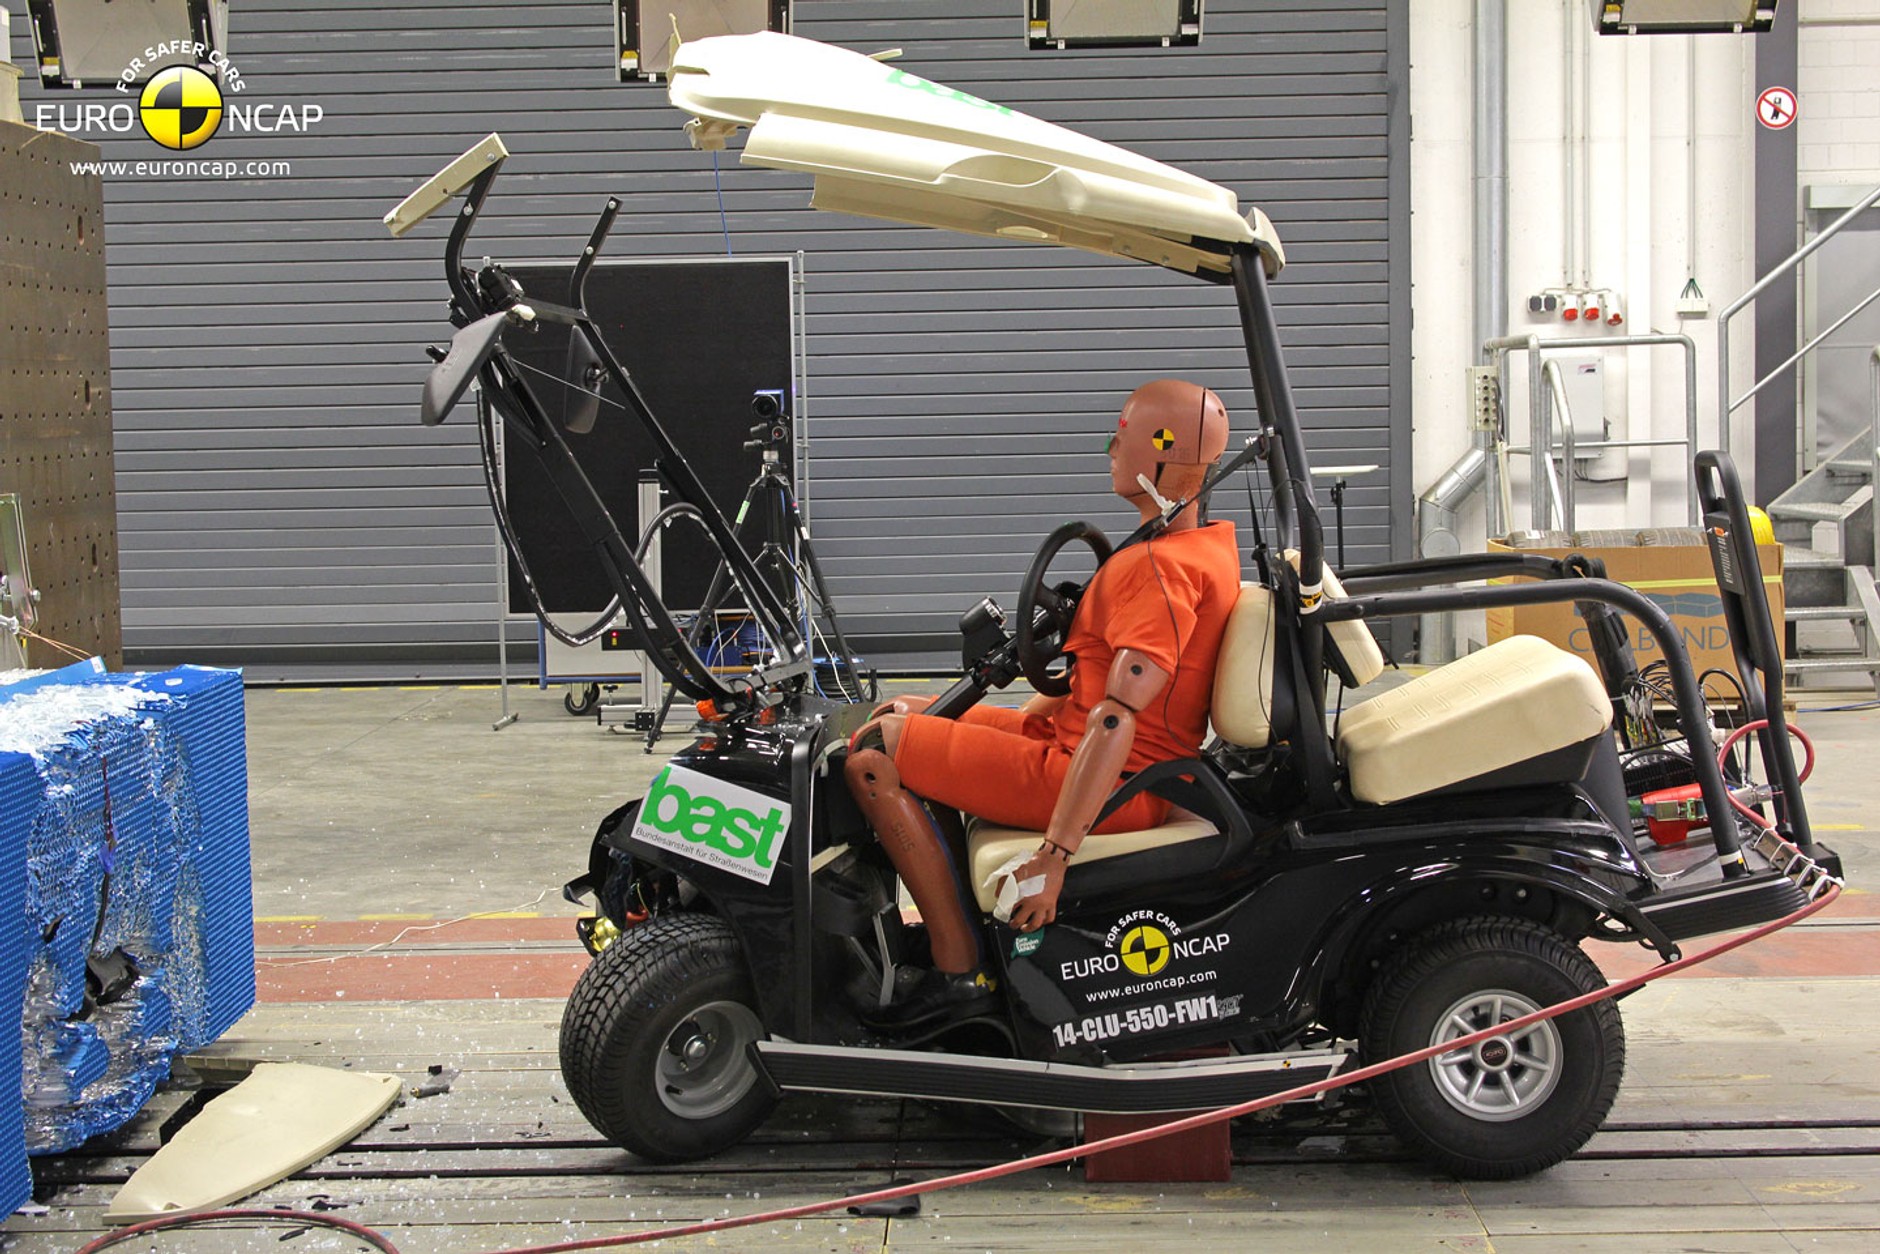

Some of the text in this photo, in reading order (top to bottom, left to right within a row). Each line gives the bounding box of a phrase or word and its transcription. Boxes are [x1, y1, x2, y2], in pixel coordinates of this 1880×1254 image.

[640, 766, 785, 869] bast
[635, 827, 768, 880] Bundesanstalt für Straßenwesen
[1104, 910, 1182, 948] FOR SAFER CARS
[1060, 933, 1230, 980] EURO NCAP
[1086, 970, 1217, 1002] www.euroncap.com
[1052, 995, 1219, 1047] 14-CLU-550-FW1
